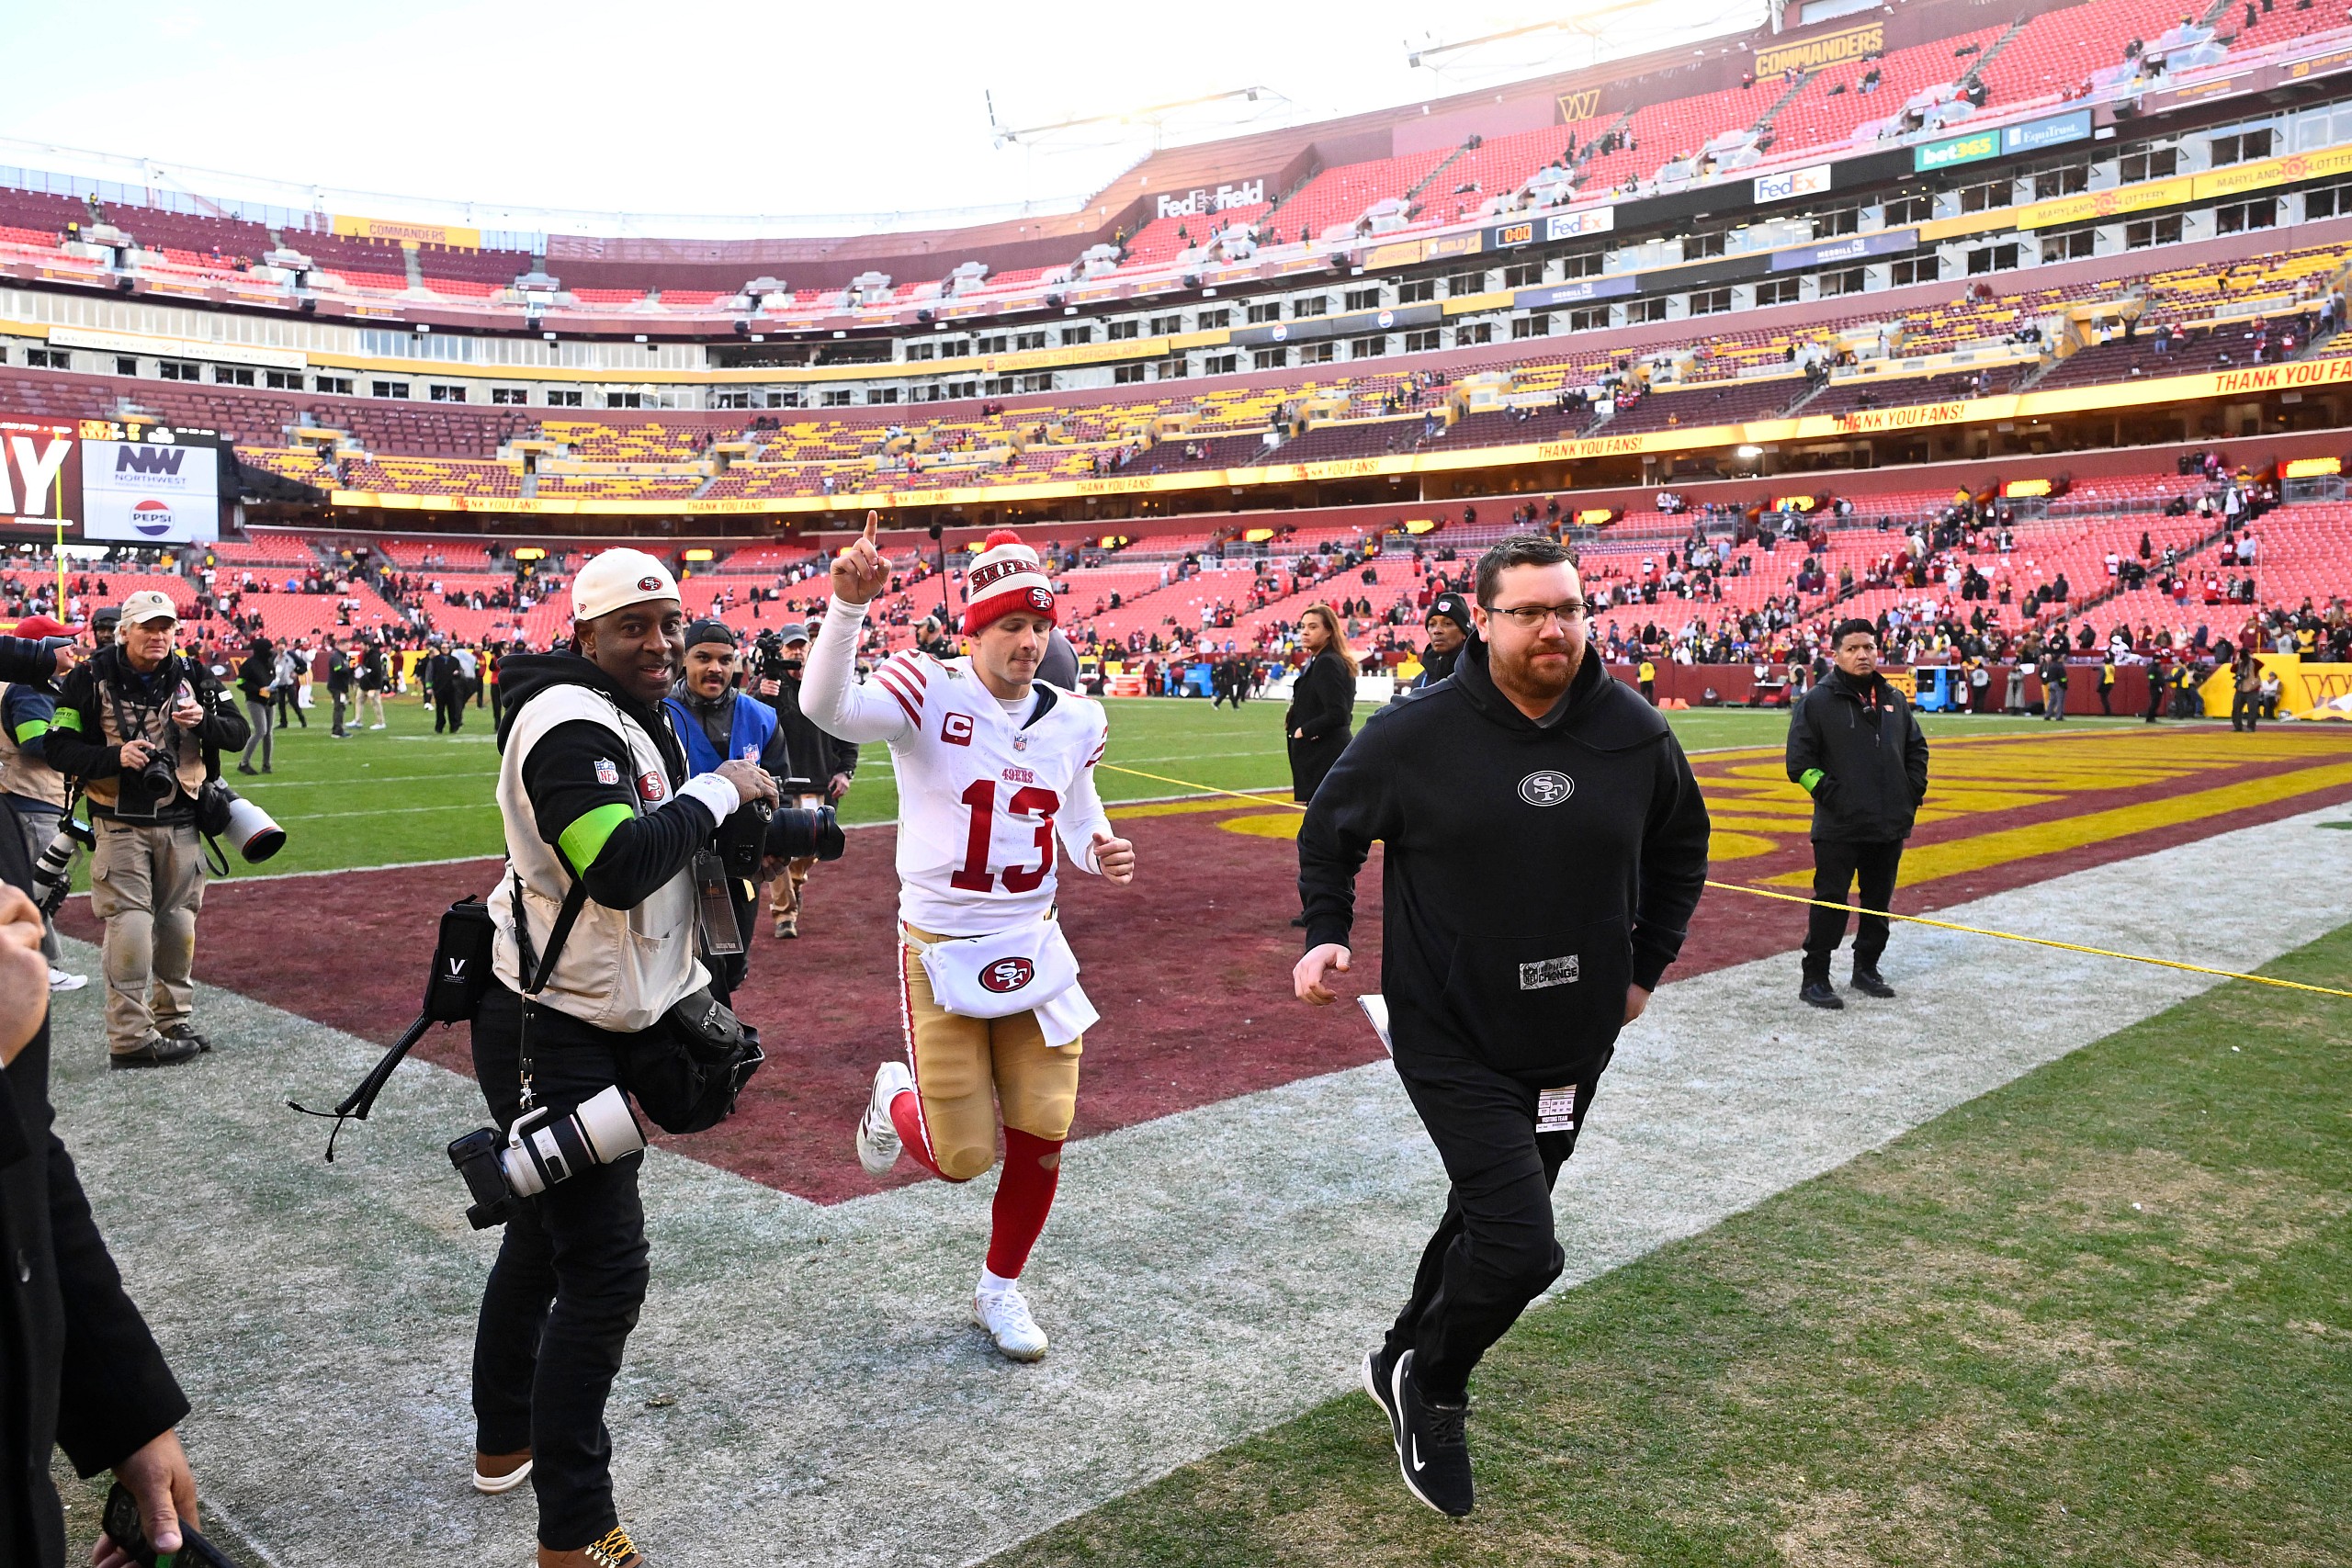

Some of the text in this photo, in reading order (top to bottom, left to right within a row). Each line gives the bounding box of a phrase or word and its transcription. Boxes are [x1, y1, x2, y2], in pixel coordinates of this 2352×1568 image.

[1755, 28, 1883, 77] COMMANDERS
[1923, 137, 1992, 165] bet365
[1759, 174, 1818, 199] FedEx
[2217, 168, 2280, 188] MARYLAND
[2038, 189, 2167, 221] MARYLAND LOTTERY
[369, 224, 447, 243] COMMANDERS
[1504, 225, 1532, 243] 0:00
[1553, 214, 1602, 237] FedEx
[997, 344, 1142, 368] DOWNLOAD THE OFFICIAL APP
[2216, 367, 2279, 392] THANK
[2286, 364, 2325, 385] YOU
[1836, 403, 1965, 432] THANK YOU FANS!
[1538, 436, 1644, 459] THANK YOU FANS!
[116, 445, 187, 476] NW
[1328, 463, 1348, 477] YOU
[115, 473, 187, 485] NORTHWEST
[1076, 481, 1104, 494] THANK
[1108, 479, 1125, 492] YOU
[490, 500, 508, 510] YOU
[687, 502, 718, 512] THANK
[721, 502, 739, 512] YOU
[133, 513, 172, 524] PEPSI
[971, 563, 1001, 592] SAN
[945, 715, 972, 738] C
[600, 770, 618, 782] NFL
[1001, 768, 1034, 784] 49ERS
[950, 778, 1061, 895] 13
[449, 957, 466, 976] V
[1539, 967, 1578, 984] CHANGE
